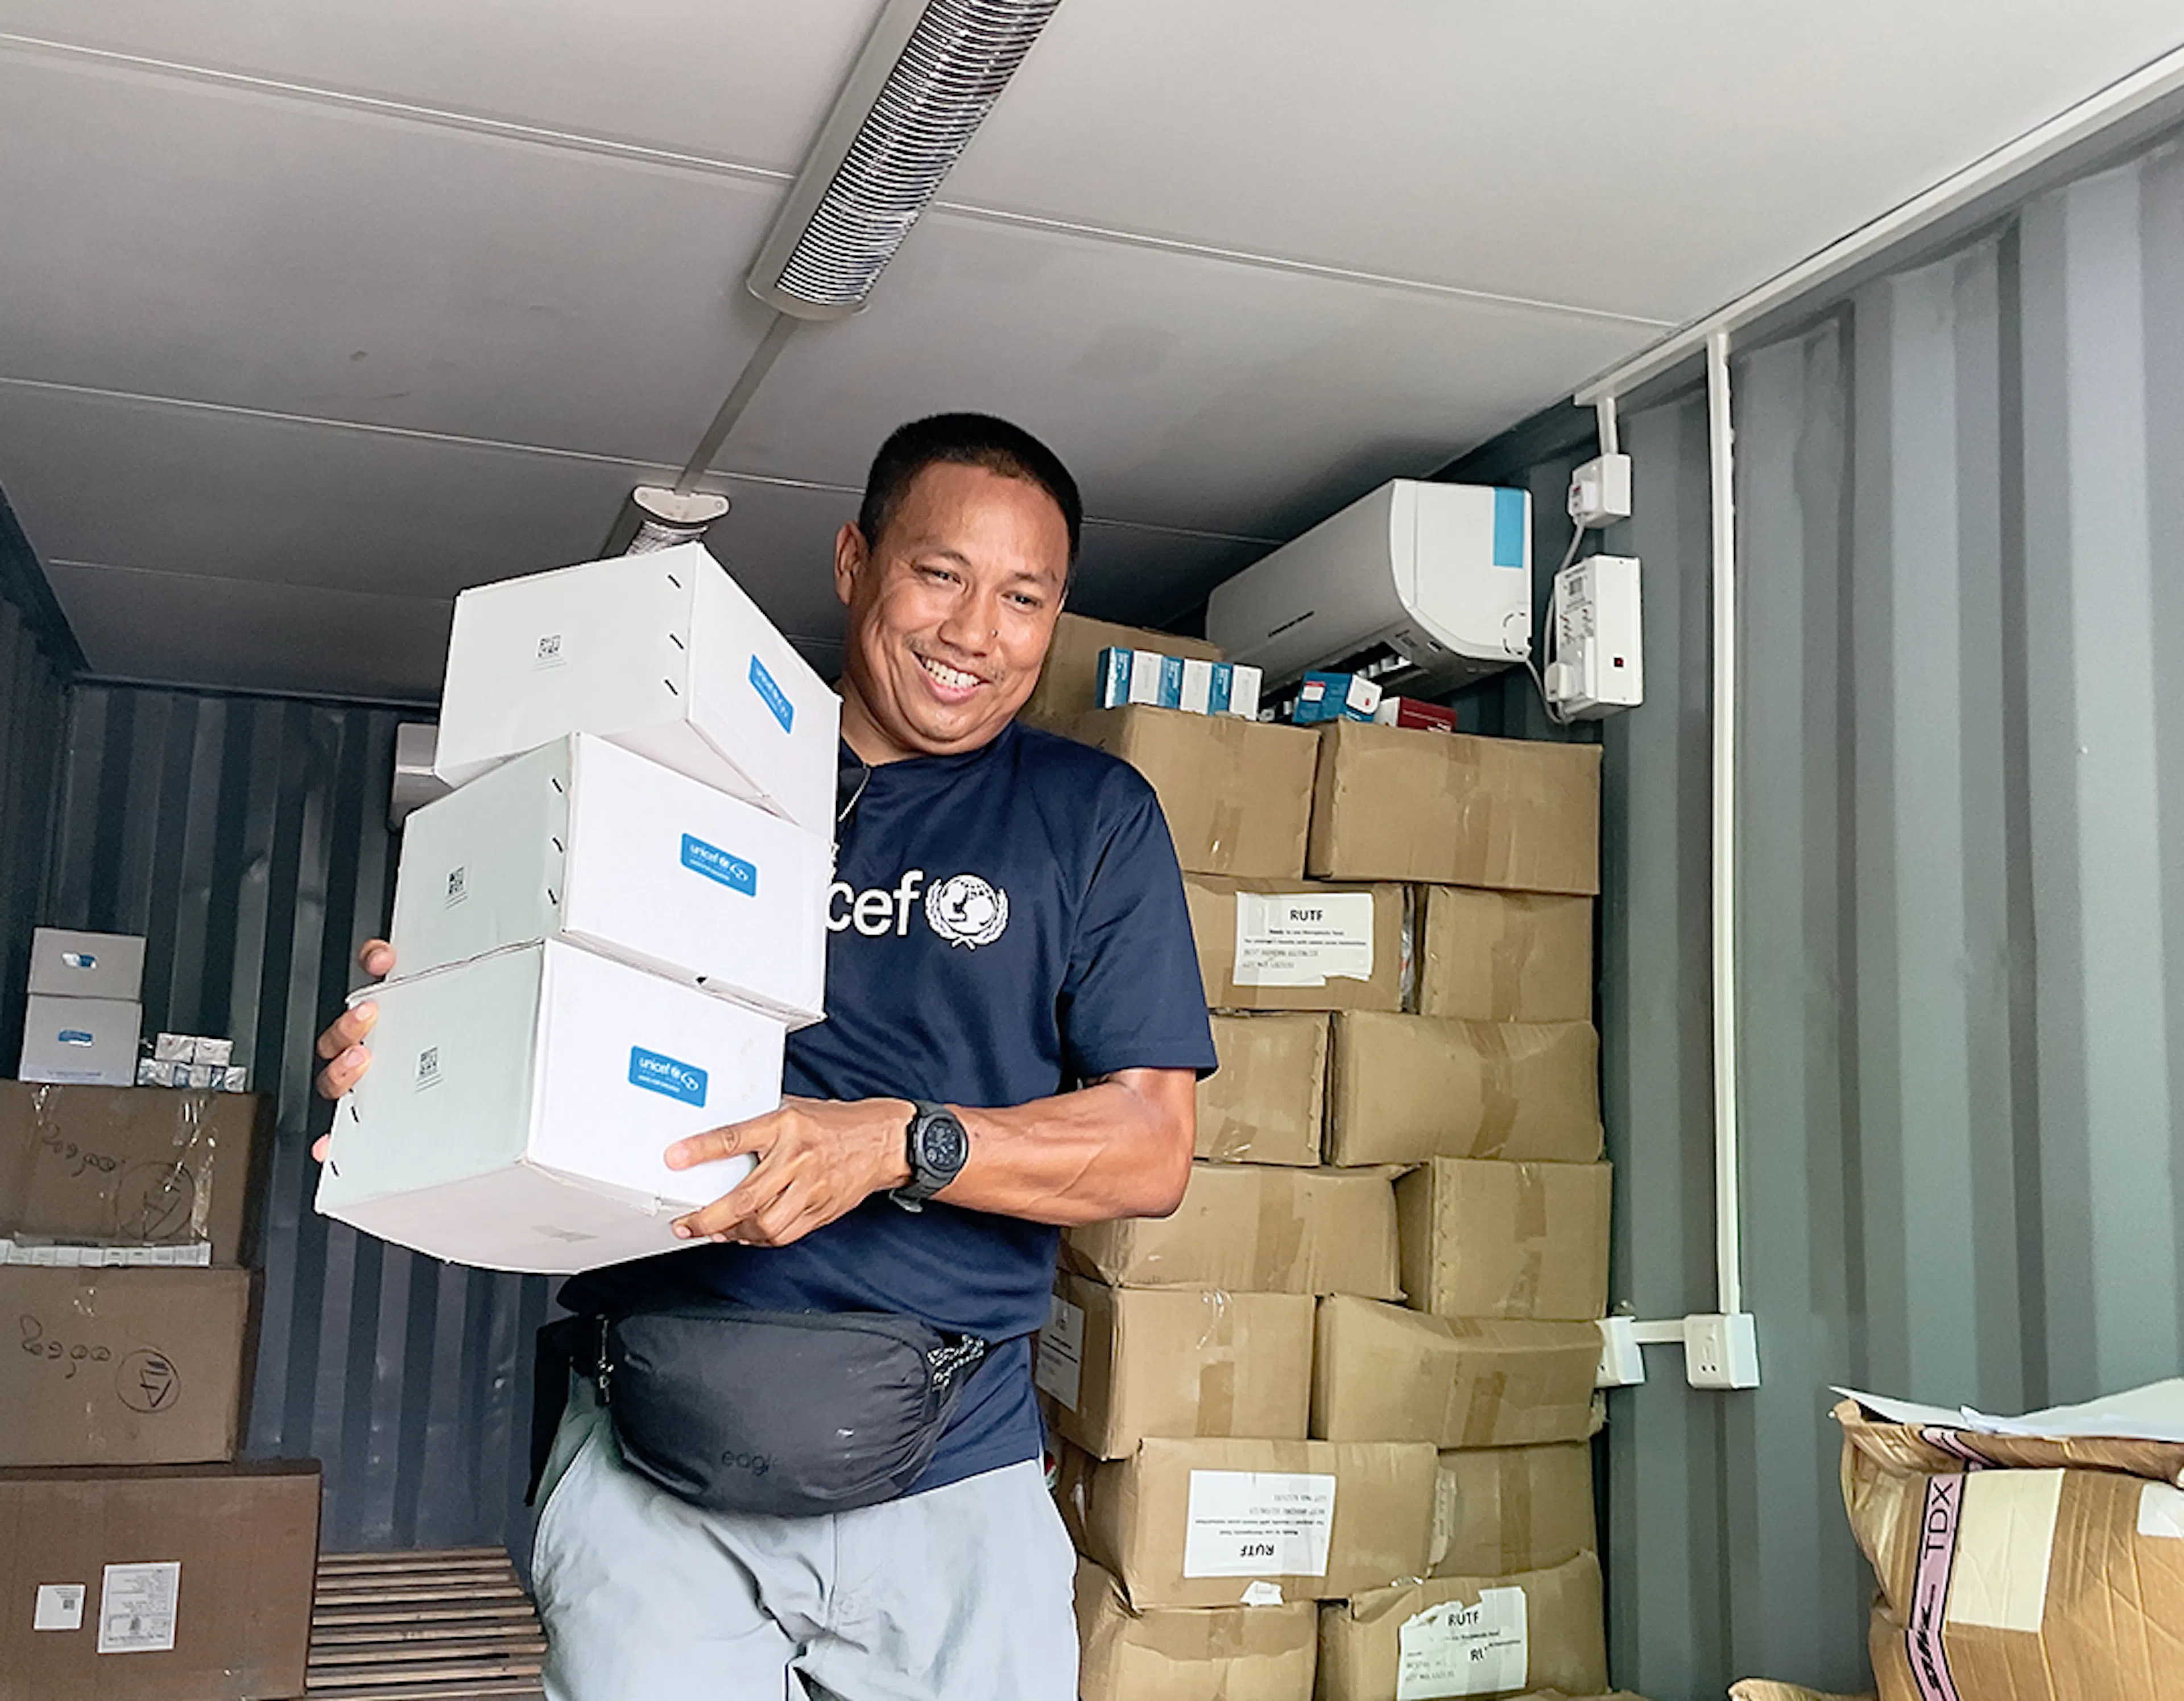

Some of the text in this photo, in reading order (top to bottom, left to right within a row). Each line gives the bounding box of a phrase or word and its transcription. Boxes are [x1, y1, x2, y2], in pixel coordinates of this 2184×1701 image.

[826, 869, 924, 936] cef
[1290, 910, 1323, 920] RUTF
[639, 1057, 671, 1075] unicef
[1924, 1482, 1953, 1560] TDX
[1240, 1543, 1275, 1557] RUTF
[1448, 1611, 1479, 1626] RUTF
